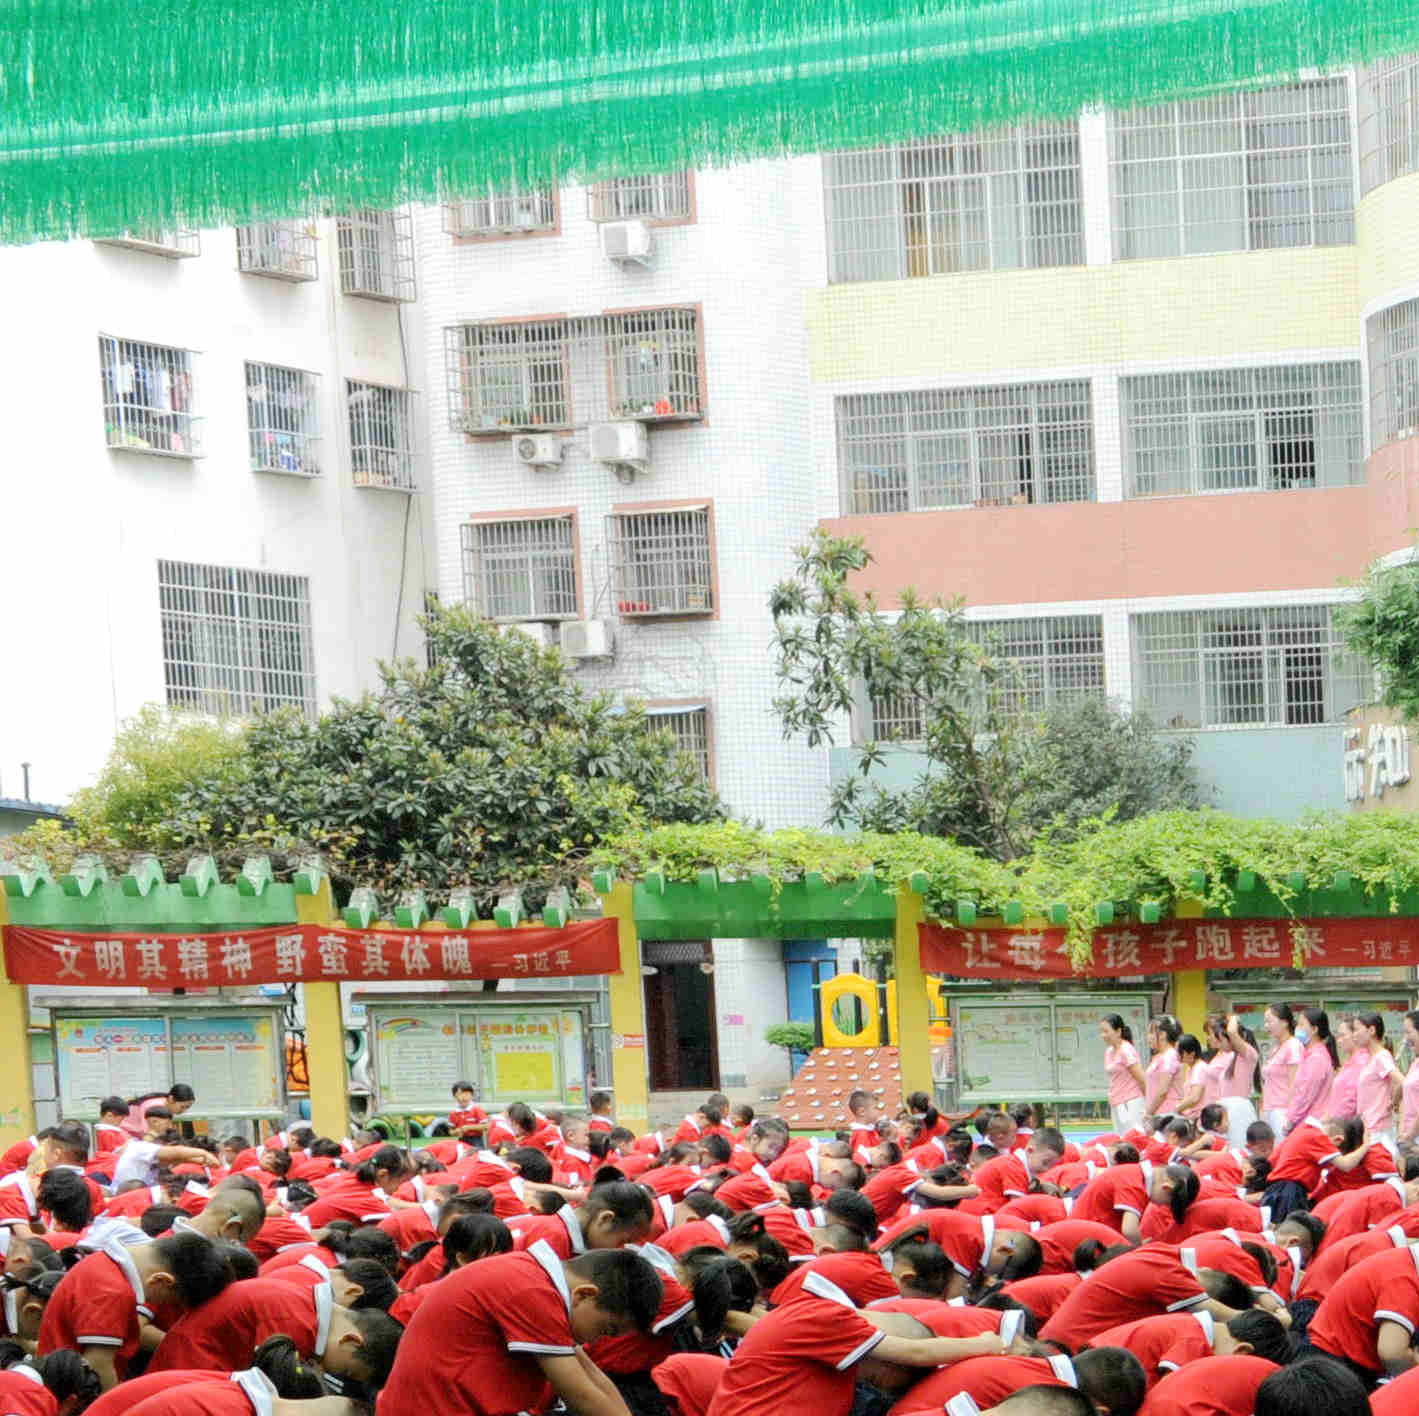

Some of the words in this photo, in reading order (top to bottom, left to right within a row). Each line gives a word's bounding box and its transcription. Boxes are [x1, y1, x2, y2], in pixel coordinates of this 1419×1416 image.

[52, 937, 252, 980] 文明其精神
[275, 932, 473, 976] 野蛮其体魄
